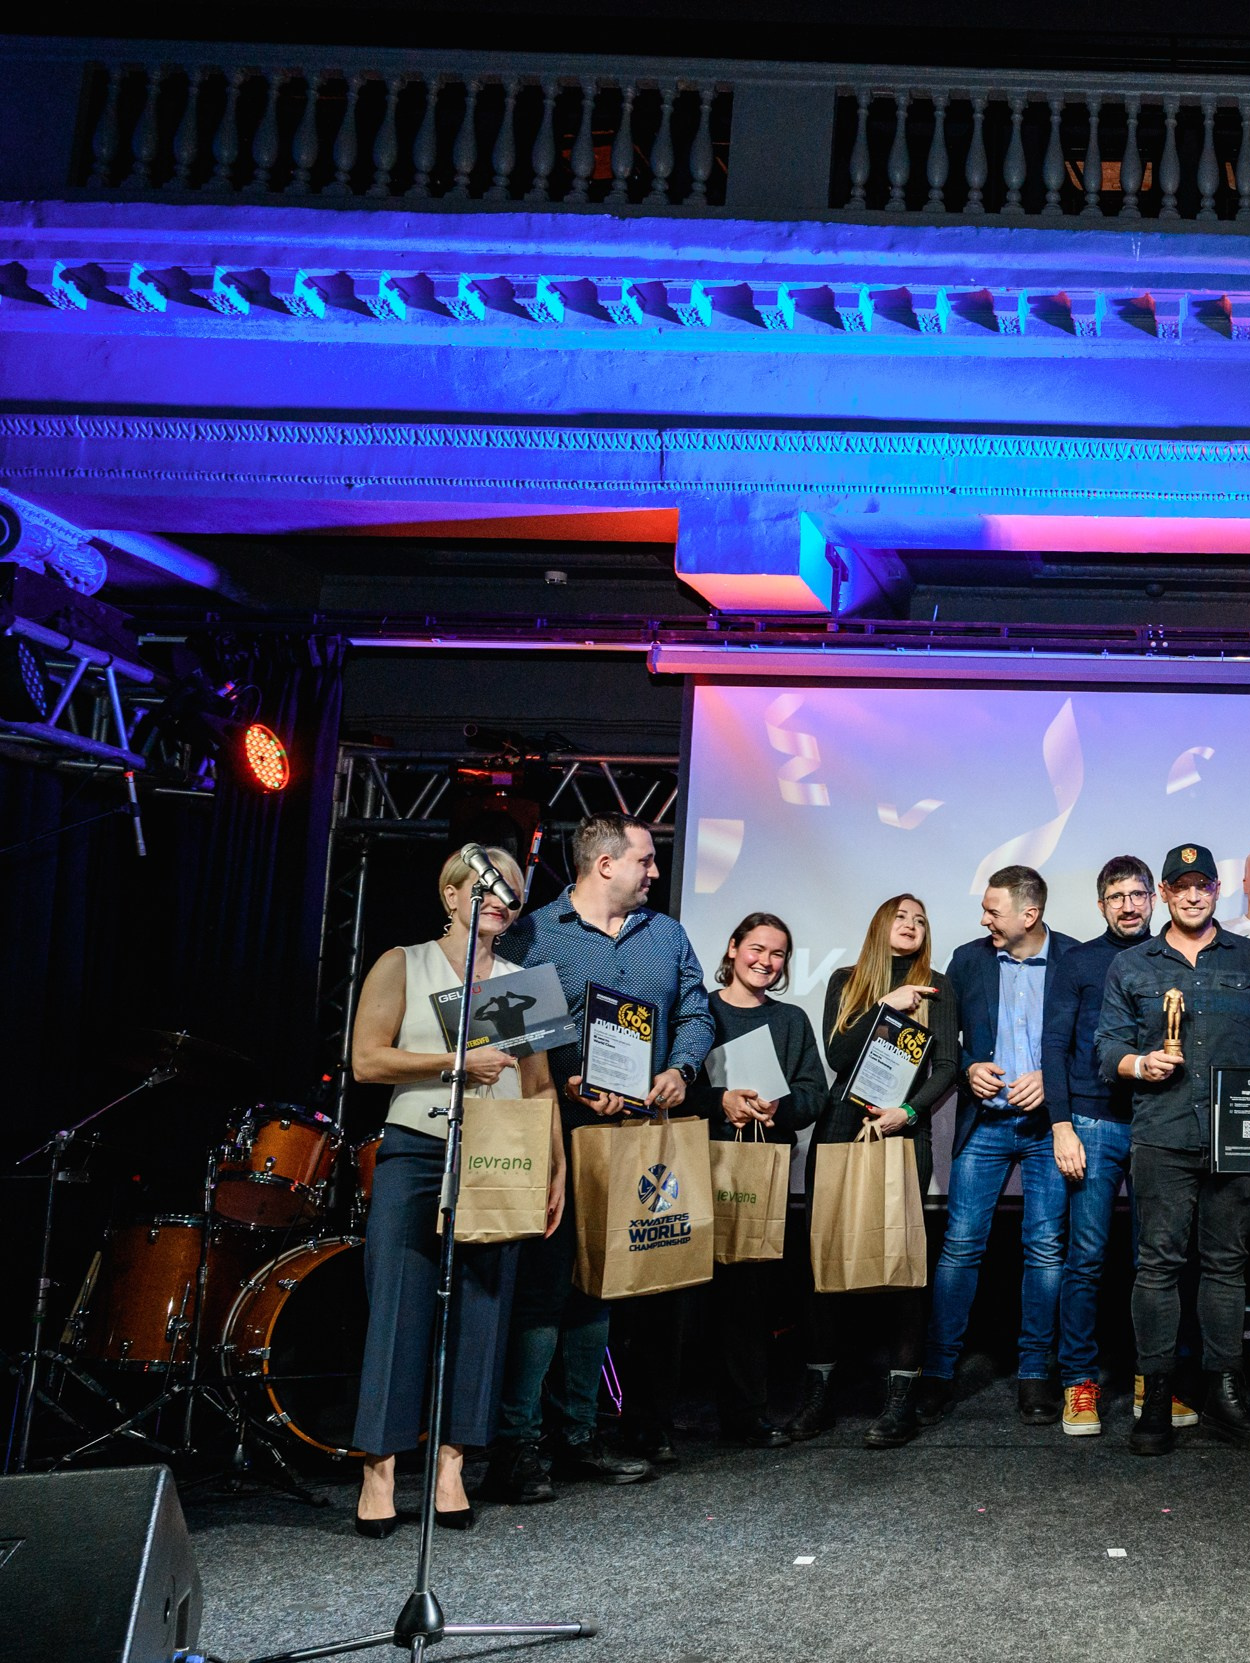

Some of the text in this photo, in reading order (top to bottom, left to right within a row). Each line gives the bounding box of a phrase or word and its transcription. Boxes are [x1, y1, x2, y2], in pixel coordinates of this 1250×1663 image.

[438, 985, 482, 1003] GELU
[594, 1018, 640, 1040] ДИПЛОМ
[625, 1010, 651, 1036] 100
[876, 1037, 912, 1062] ДИПЛОМ
[904, 1034, 923, 1059] 100
[468, 1155, 533, 1171] levrana
[628, 1222, 692, 1243] WORLD
[629, 1237, 691, 1252] CHAMPIONSHIP
